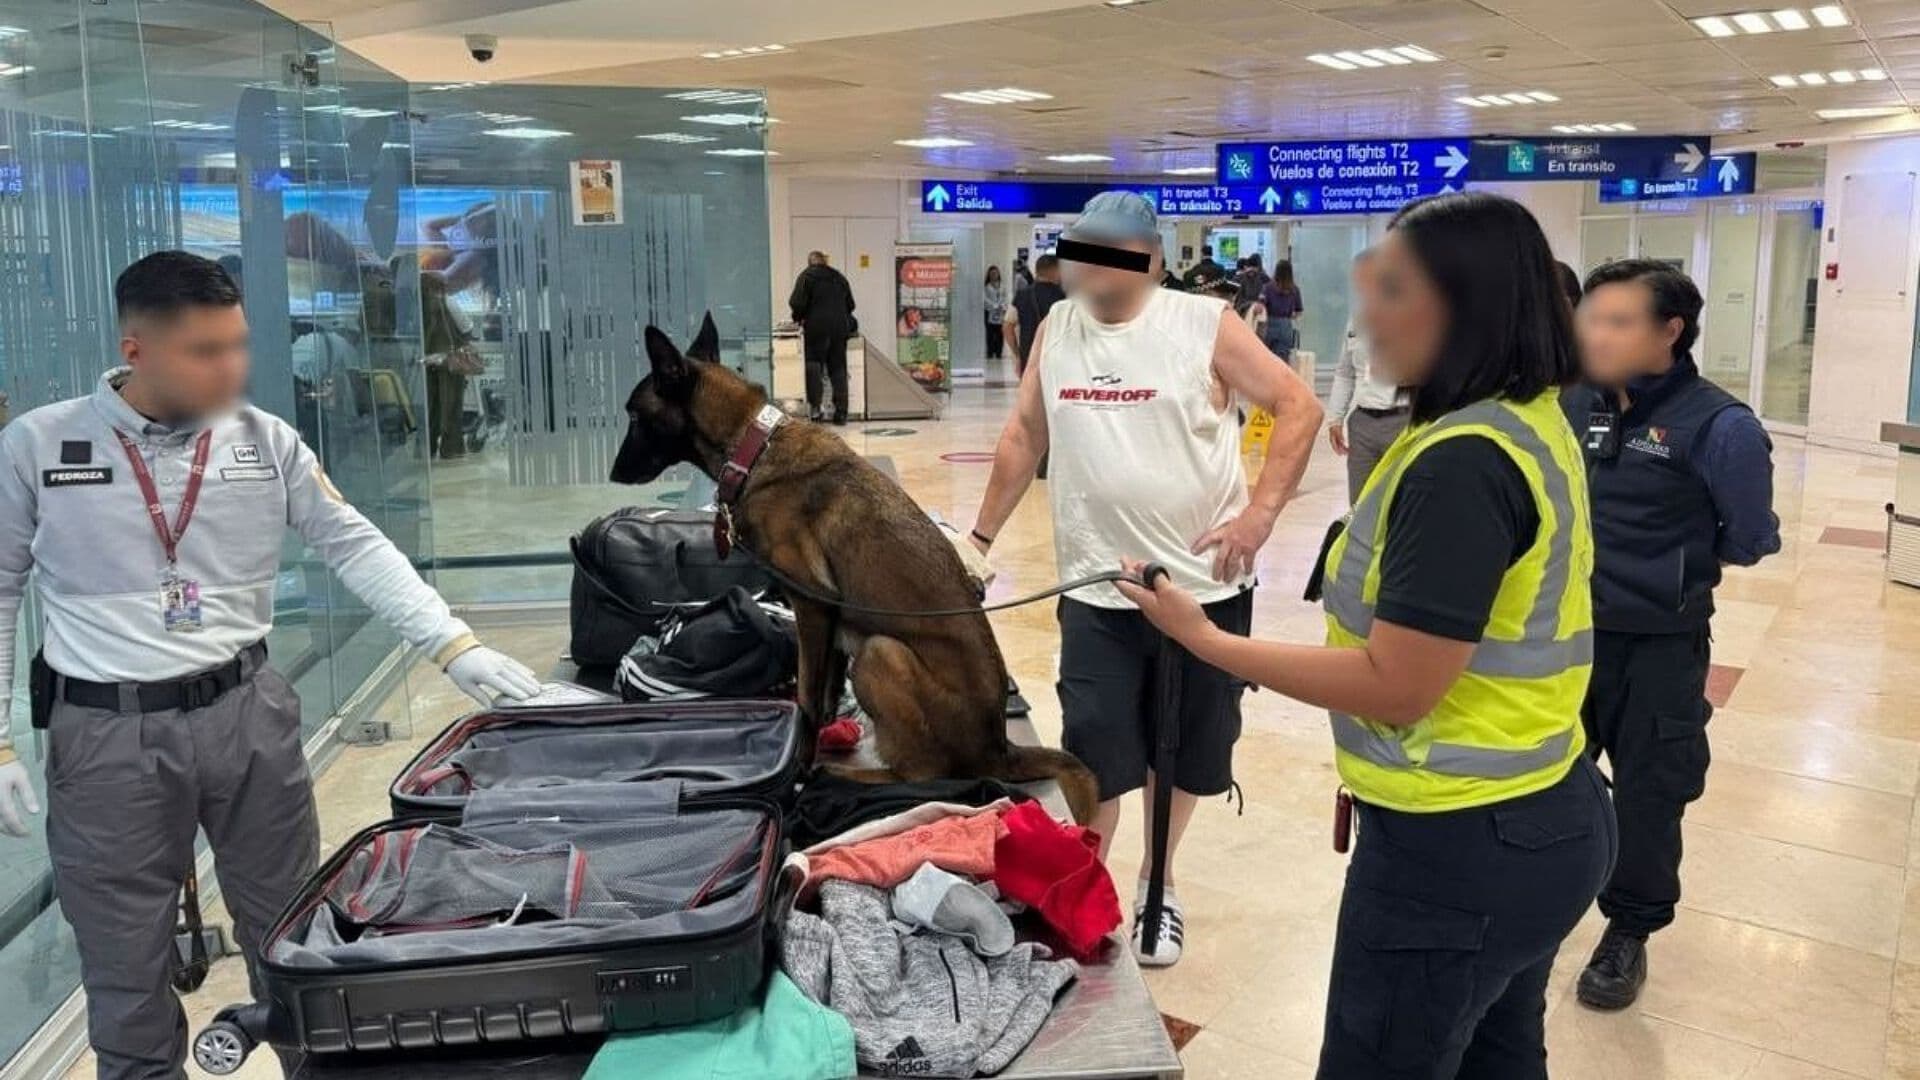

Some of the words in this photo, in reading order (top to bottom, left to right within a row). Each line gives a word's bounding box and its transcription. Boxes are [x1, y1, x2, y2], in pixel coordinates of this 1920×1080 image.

[1269, 145, 1343, 163] Connecting
[1347, 143, 1387, 162] flights
[1391, 143, 1409, 159] T2
[1269, 164, 1314, 179] Vuelos
[1318, 163, 1334, 178] de
[1338, 161, 1397, 177] conexión
[1401, 160, 1420, 176] T2
[1548, 160, 1566, 173] En
[956, 183, 978, 196] Exit
[1162, 187, 1173, 198] In
[1176, 187, 1210, 198] transit
[1214, 187, 1229, 198] T3
[1321, 185, 1373, 199] Connecting
[1375, 184, 1403, 198] flights
[956, 197, 993, 209] Salida
[1162, 199, 1177, 211] En
[1225, 199, 1242, 211] T3
[1321, 199, 1353, 210] Vuelos
[1355, 198, 1367, 209] de
[1059, 388, 1120, 401] NEVER
[1121, 389, 1159, 401] OFF
[50, 470, 105, 482] PEDROZA
